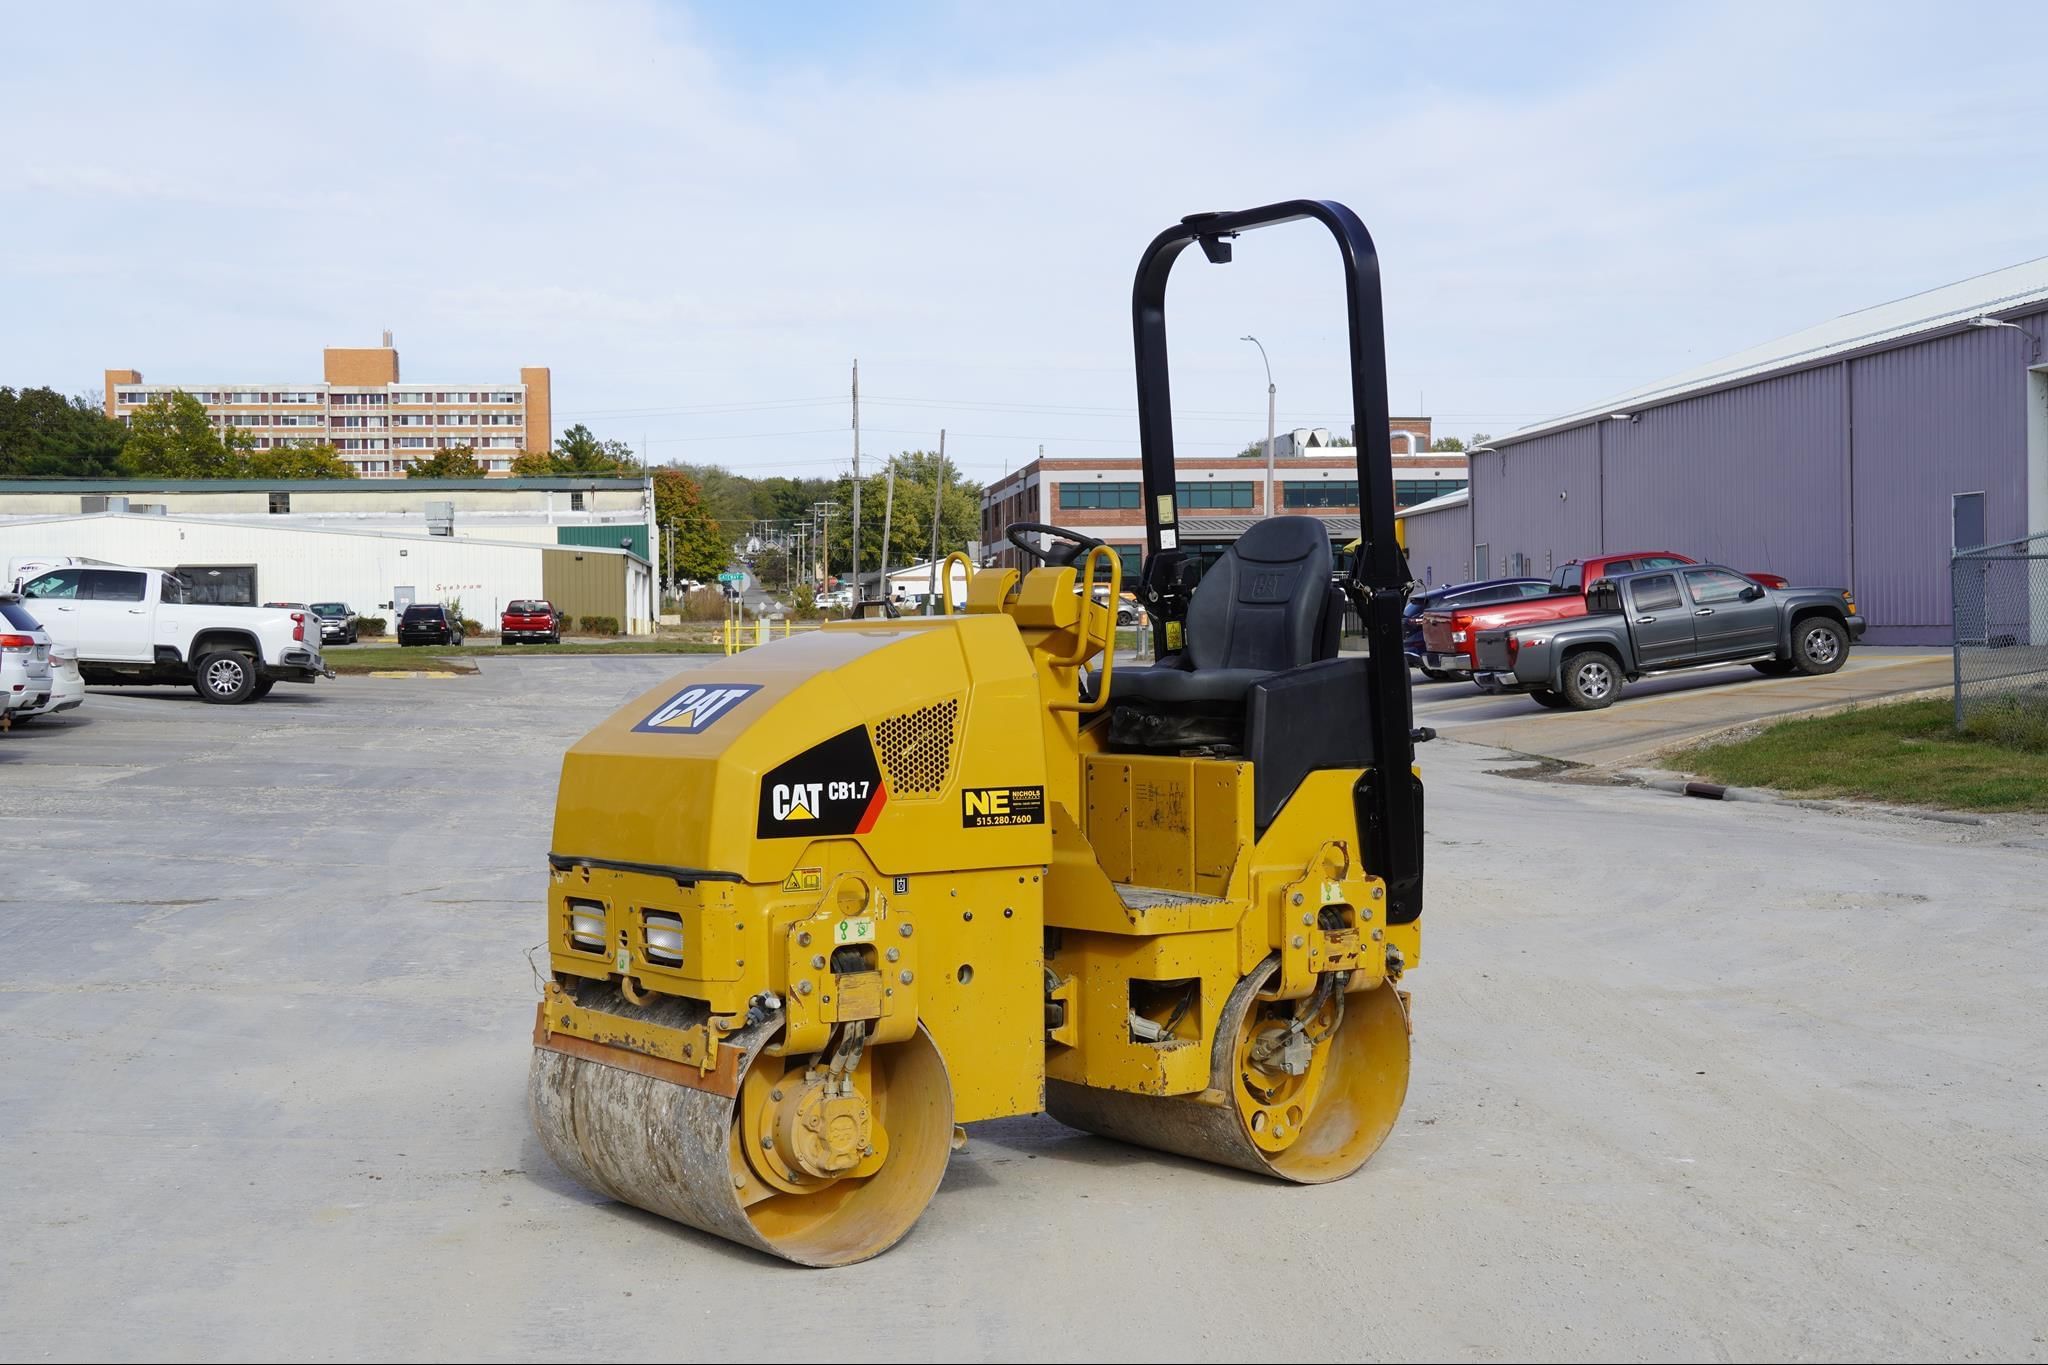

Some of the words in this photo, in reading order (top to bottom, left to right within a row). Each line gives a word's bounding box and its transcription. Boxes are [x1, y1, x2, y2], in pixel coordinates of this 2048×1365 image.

[648, 689, 749, 727] CAT
[773, 783, 823, 820] CAT
[828, 781, 869, 800] CB1.7
[965, 790, 1010, 816] NE
[976, 815, 1031, 825] 515.280.7600
